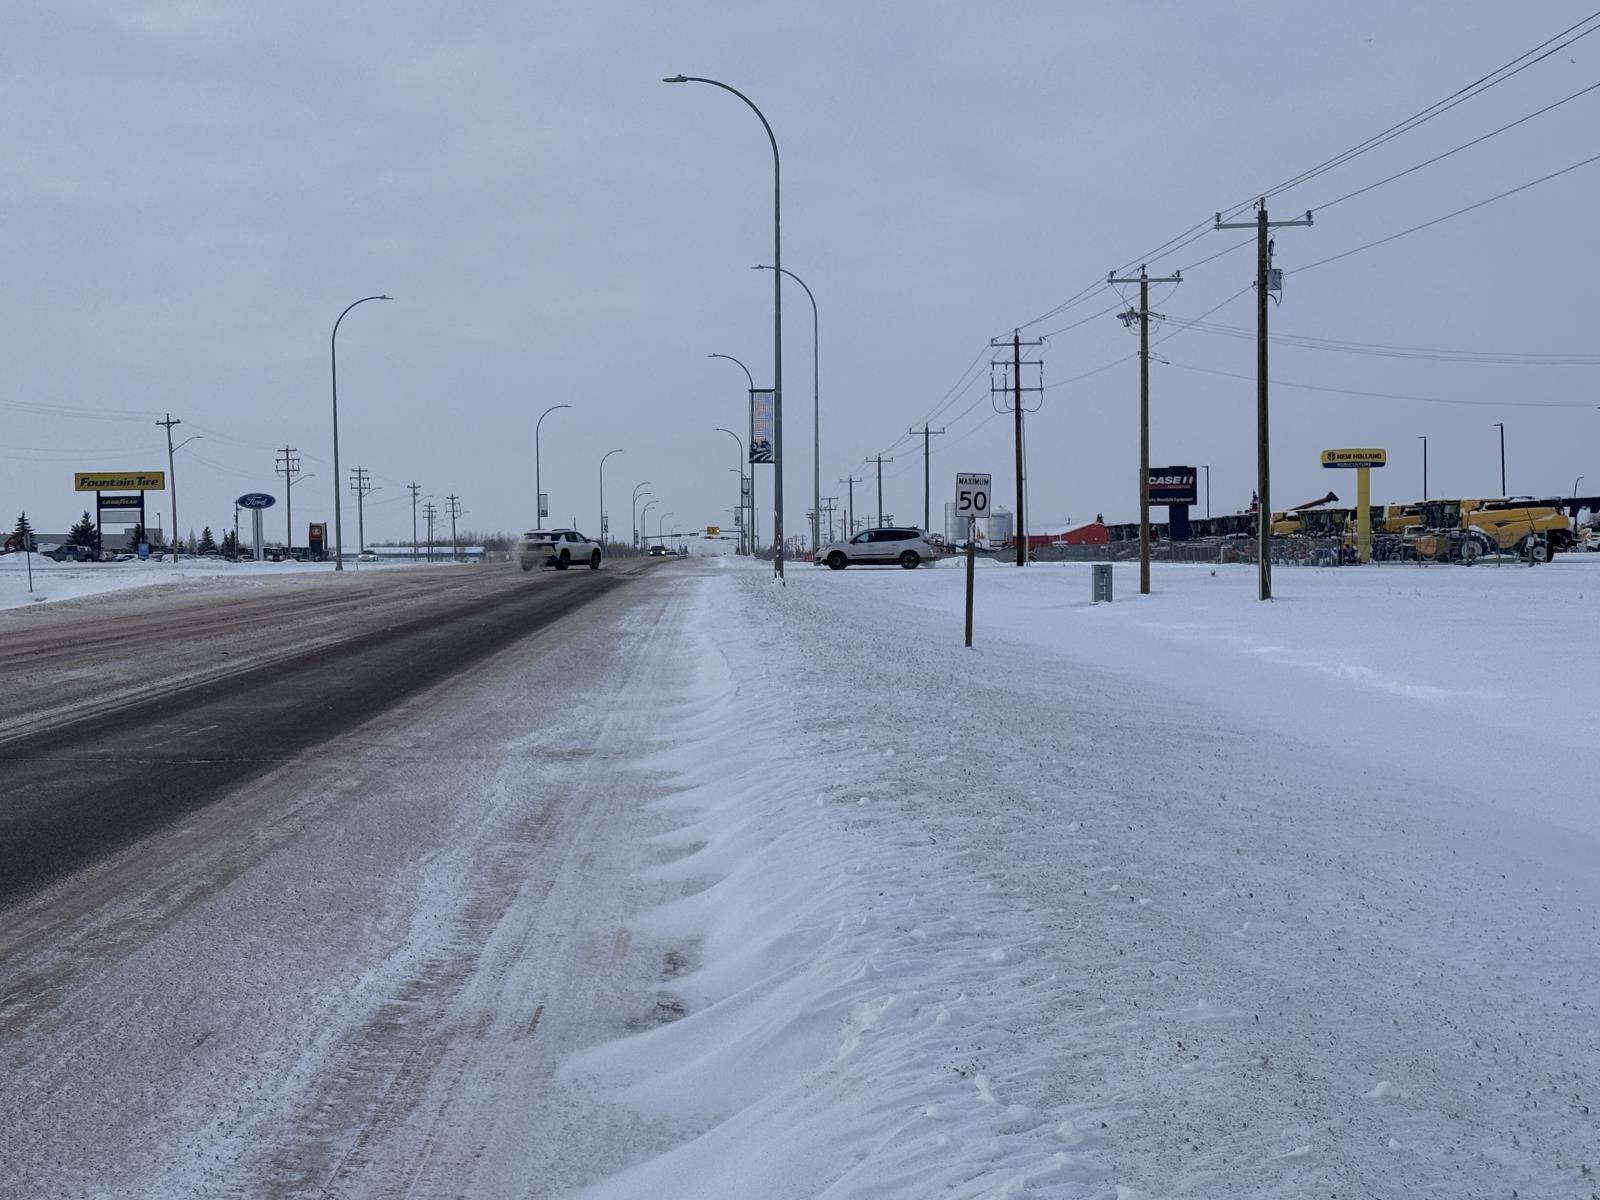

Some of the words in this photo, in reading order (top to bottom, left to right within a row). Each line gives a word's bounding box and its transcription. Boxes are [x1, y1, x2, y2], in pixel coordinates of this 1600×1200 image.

[80, 477, 135, 487] Fountain
[136, 476, 159, 486] Tire
[958, 477, 989, 486] MAXIMUM
[1149, 476, 1182, 485] CASE
[245, 496, 268, 506] Ford
[959, 491, 987, 511] 50
